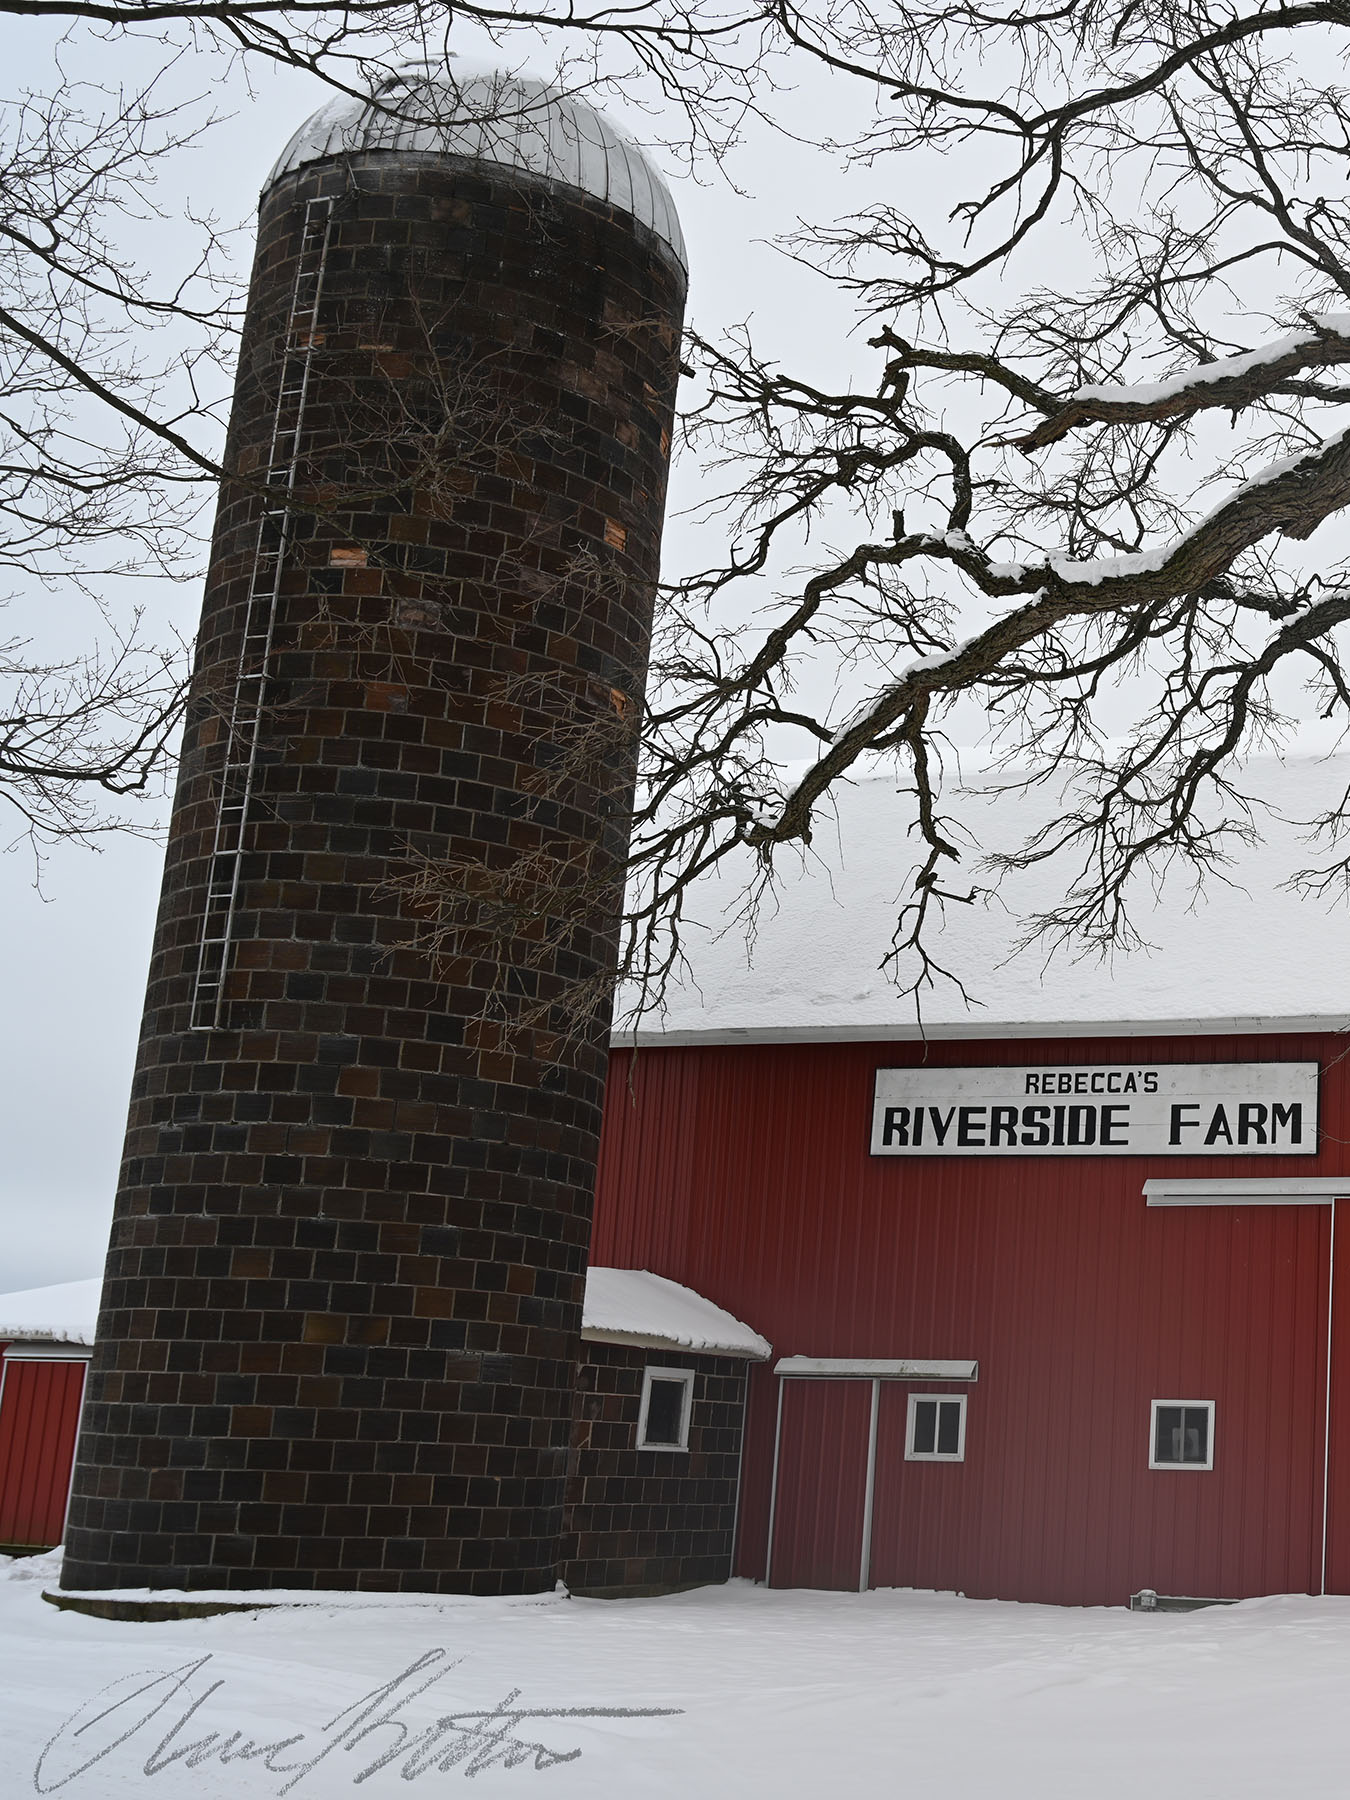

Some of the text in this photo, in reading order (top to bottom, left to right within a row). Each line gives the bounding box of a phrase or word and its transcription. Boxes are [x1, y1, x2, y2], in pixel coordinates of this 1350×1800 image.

[1024, 1071, 1159, 1095] REBECCA'S
[882, 1102, 1303, 1147] RIVERSIDE FARM
